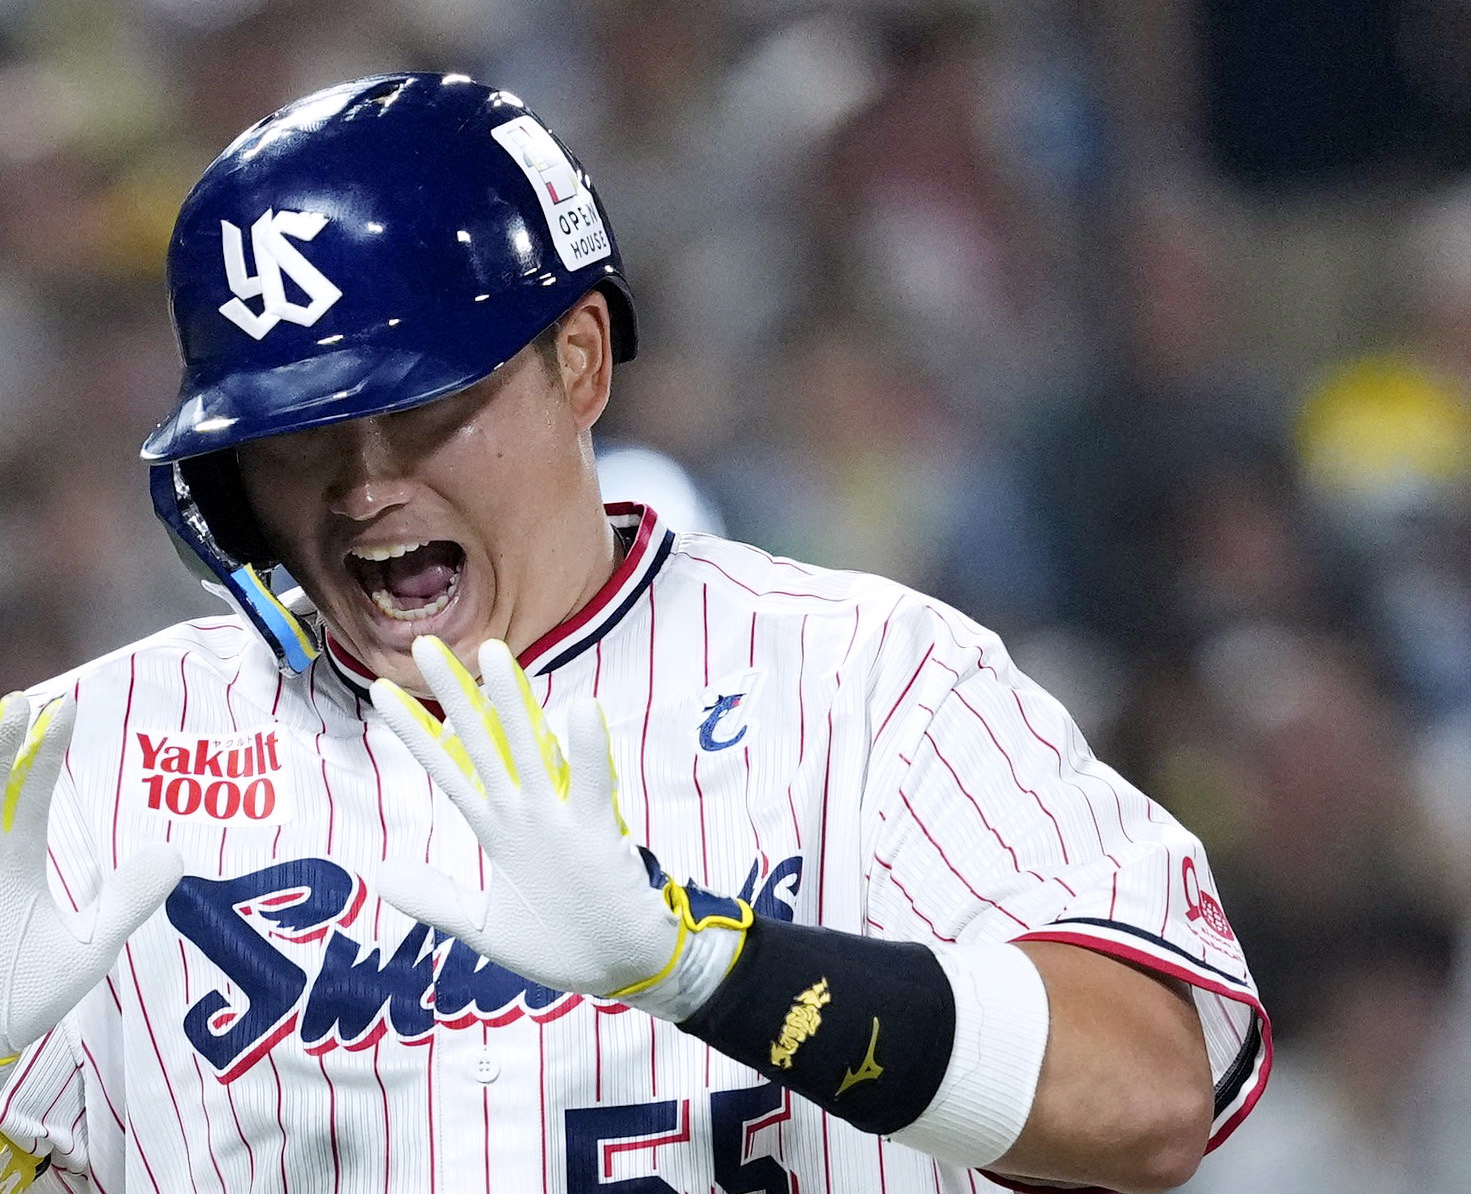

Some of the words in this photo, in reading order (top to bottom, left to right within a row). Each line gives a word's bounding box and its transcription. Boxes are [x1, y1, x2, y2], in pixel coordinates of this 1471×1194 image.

[559, 202, 598, 235] OPEN
[571, 231, 607, 259] HOUSE
[136, 730, 282, 778] Yakult
[141, 774, 276, 820] 1000
